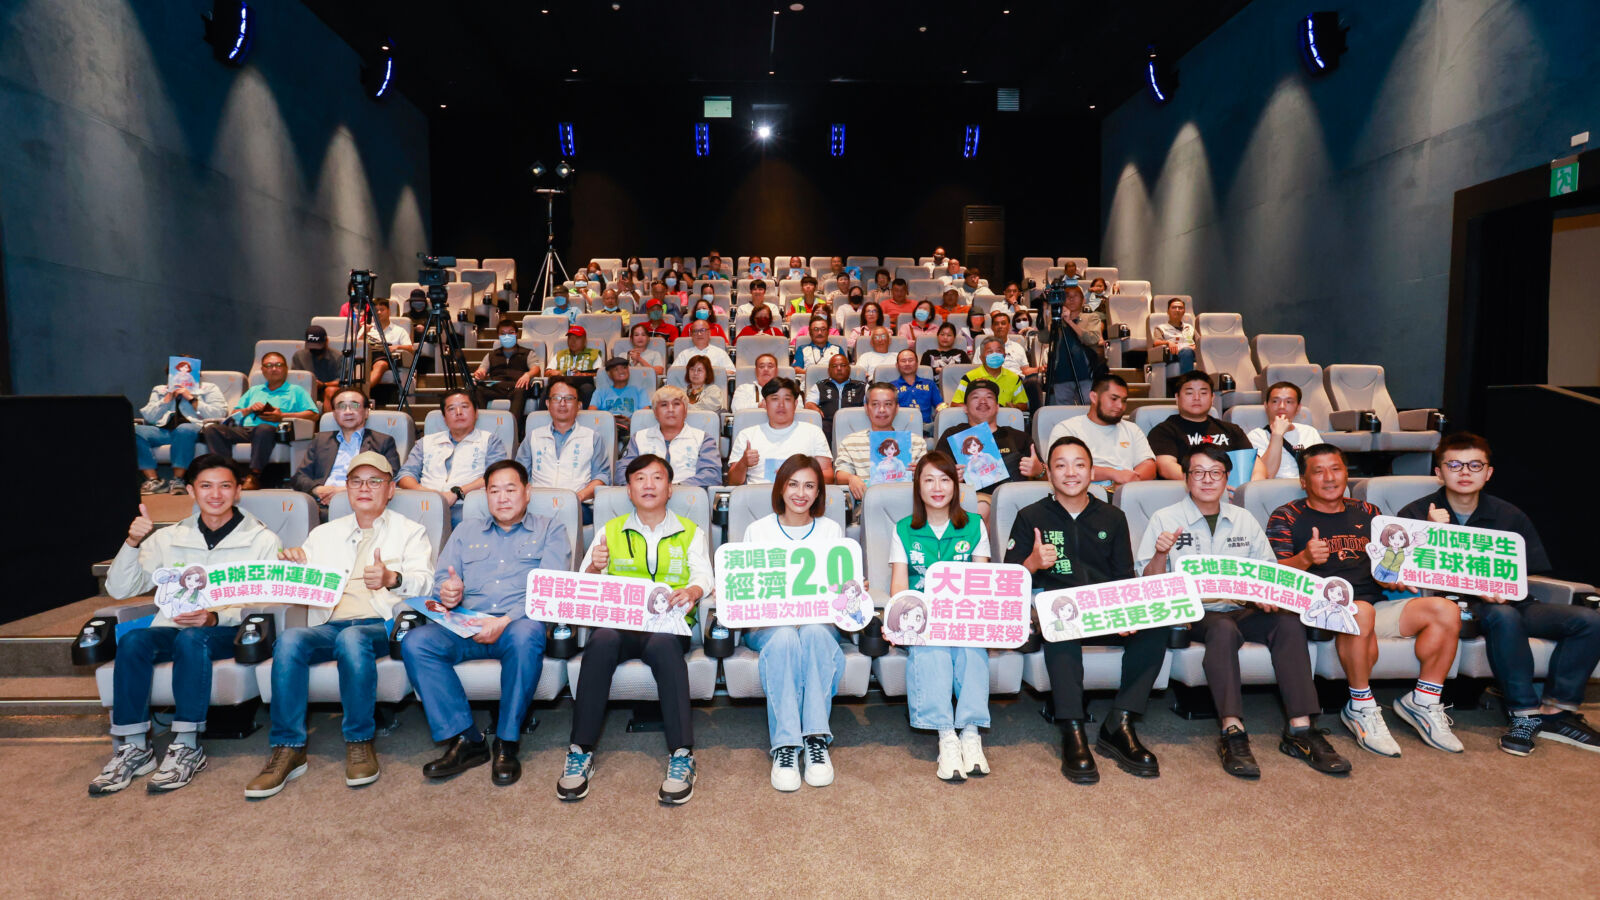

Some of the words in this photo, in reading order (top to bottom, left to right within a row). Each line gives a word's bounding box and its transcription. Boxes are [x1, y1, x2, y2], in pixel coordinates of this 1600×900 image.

[1427, 527, 1518, 557] 加碼學生
[724, 547, 787, 570] 演唱會
[790, 545, 854, 596] 2.0
[1412, 547, 1518, 582] 看球補助
[207, 564, 342, 591] 申辦亞洲運動會
[531, 574, 646, 607] 增設三萬個
[725, 571, 787, 602] 經濟
[932, 566, 1025, 598] 大巨蛋
[1181, 558, 1315, 596] 在地藝文國際化
[1402, 568, 1519, 597] 強化高雄主場認同
[209, 583, 336, 604] 爭取桌球、羽球等賽事
[1075, 576, 1188, 611] 發展夜經濟
[530, 598, 645, 627] 汽、機車停車格
[727, 600, 830, 621] 演出場次加倍
[931, 598, 1024, 622] 結合造鎮
[1081, 598, 1196, 632] 生活更多元
[929, 622, 1024, 643] 高雄更繁榮
